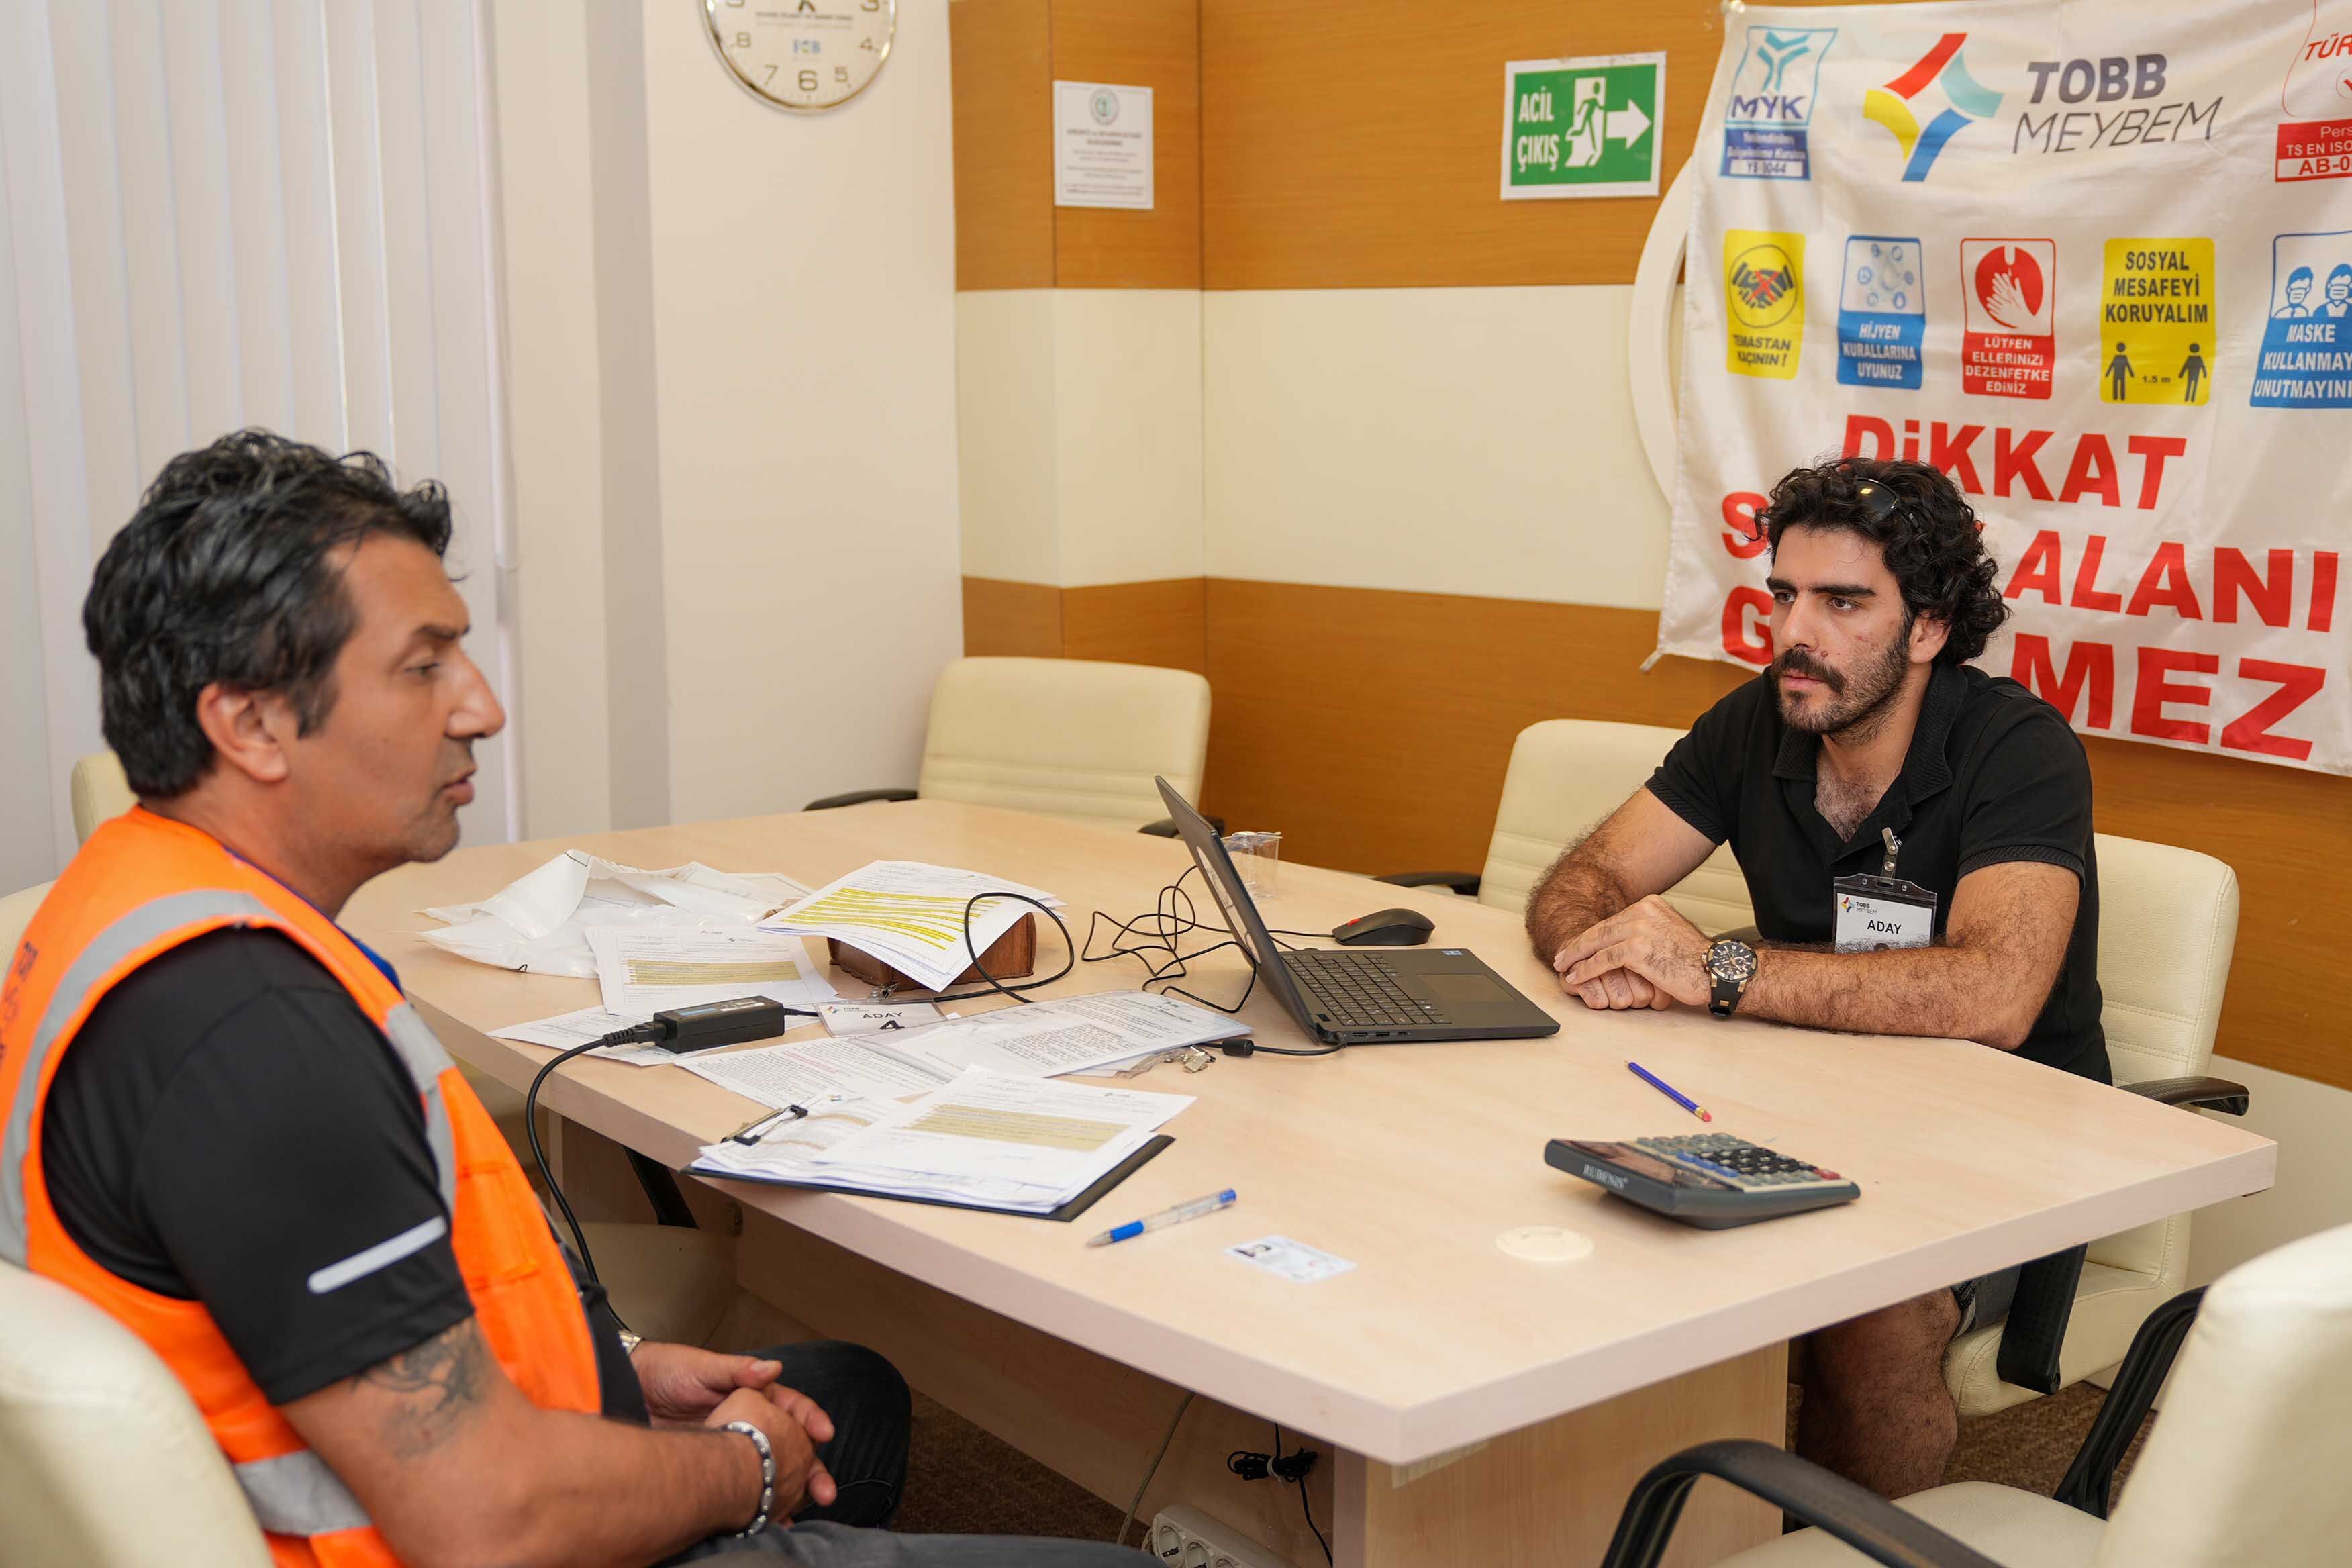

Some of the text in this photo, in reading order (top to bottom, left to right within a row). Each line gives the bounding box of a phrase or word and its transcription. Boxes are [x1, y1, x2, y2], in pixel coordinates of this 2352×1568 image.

[736, 32, 752, 48] 8
[859, 37, 873, 52] 4
[764, 64, 779, 86] 7
[798, 70, 818, 91] 6
[834, 66, 849, 83] 5
[2027, 53, 2167, 104] TOBB
[1518, 85, 1555, 123] ACİL
[1732, 95, 1806, 119] MYK
[2013, 96, 2223, 154] MEYBEM
[1516, 134, 1559, 173] ÇIKIŞ
[2286, 140, 2352, 156] TS EN ISO
[2126, 251, 2189, 271] SOSYAL
[2113, 273, 2200, 297] MESAFEYİ
[2106, 303, 2208, 323] KORUYALIM
[1859, 320, 1901, 341] HİJYEN
[2286, 324, 2336, 343] MASKE
[1842, 342, 1916, 360] KURALLARINA
[1984, 336, 2032, 350] LÜTFEN
[1857, 362, 1902, 380] UYUNUZ
[1965, 365, 2050, 381] DEZENFETKE
[2142, 375, 2157, 383] 1.5
[2004, 529, 2339, 632] ALANI
[1867, 920, 1902, 934] ADAY
